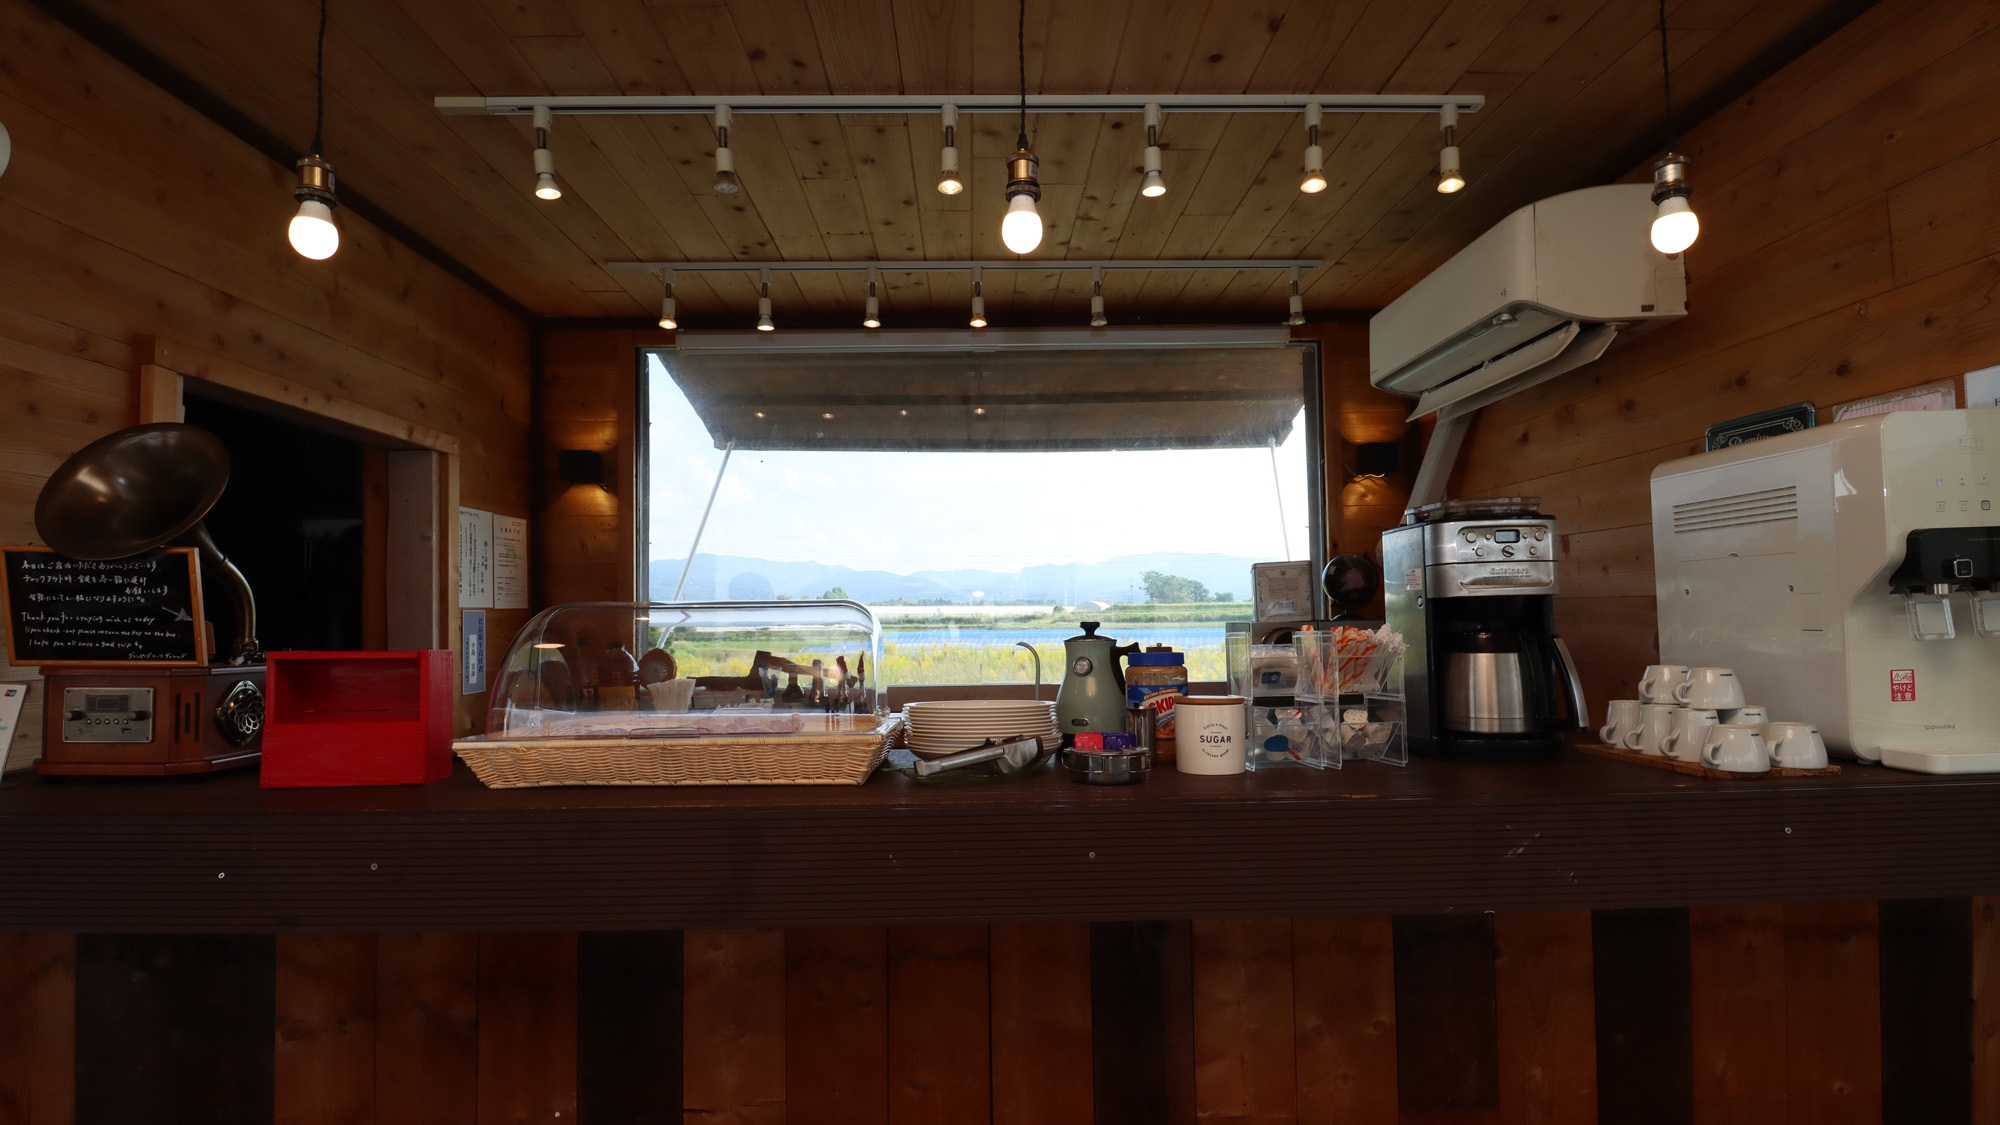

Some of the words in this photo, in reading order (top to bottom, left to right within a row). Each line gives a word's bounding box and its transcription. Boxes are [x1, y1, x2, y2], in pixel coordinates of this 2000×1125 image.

[1957, 436, 1985, 444] WATER
[1489, 567, 1529, 575] Cuisinart
[21, 611, 45, 622] Thank
[61, 611, 73, 624] for
[76, 615, 103, 624] staying
[134, 616, 155, 626] today
[34, 639, 49, 648] hope
[1893, 684, 1913, 692] やけど
[1143, 691, 1159, 700] EXTRA
[1894, 692, 1912, 701] 注意
[1199, 735, 1232, 743] SUGAR
